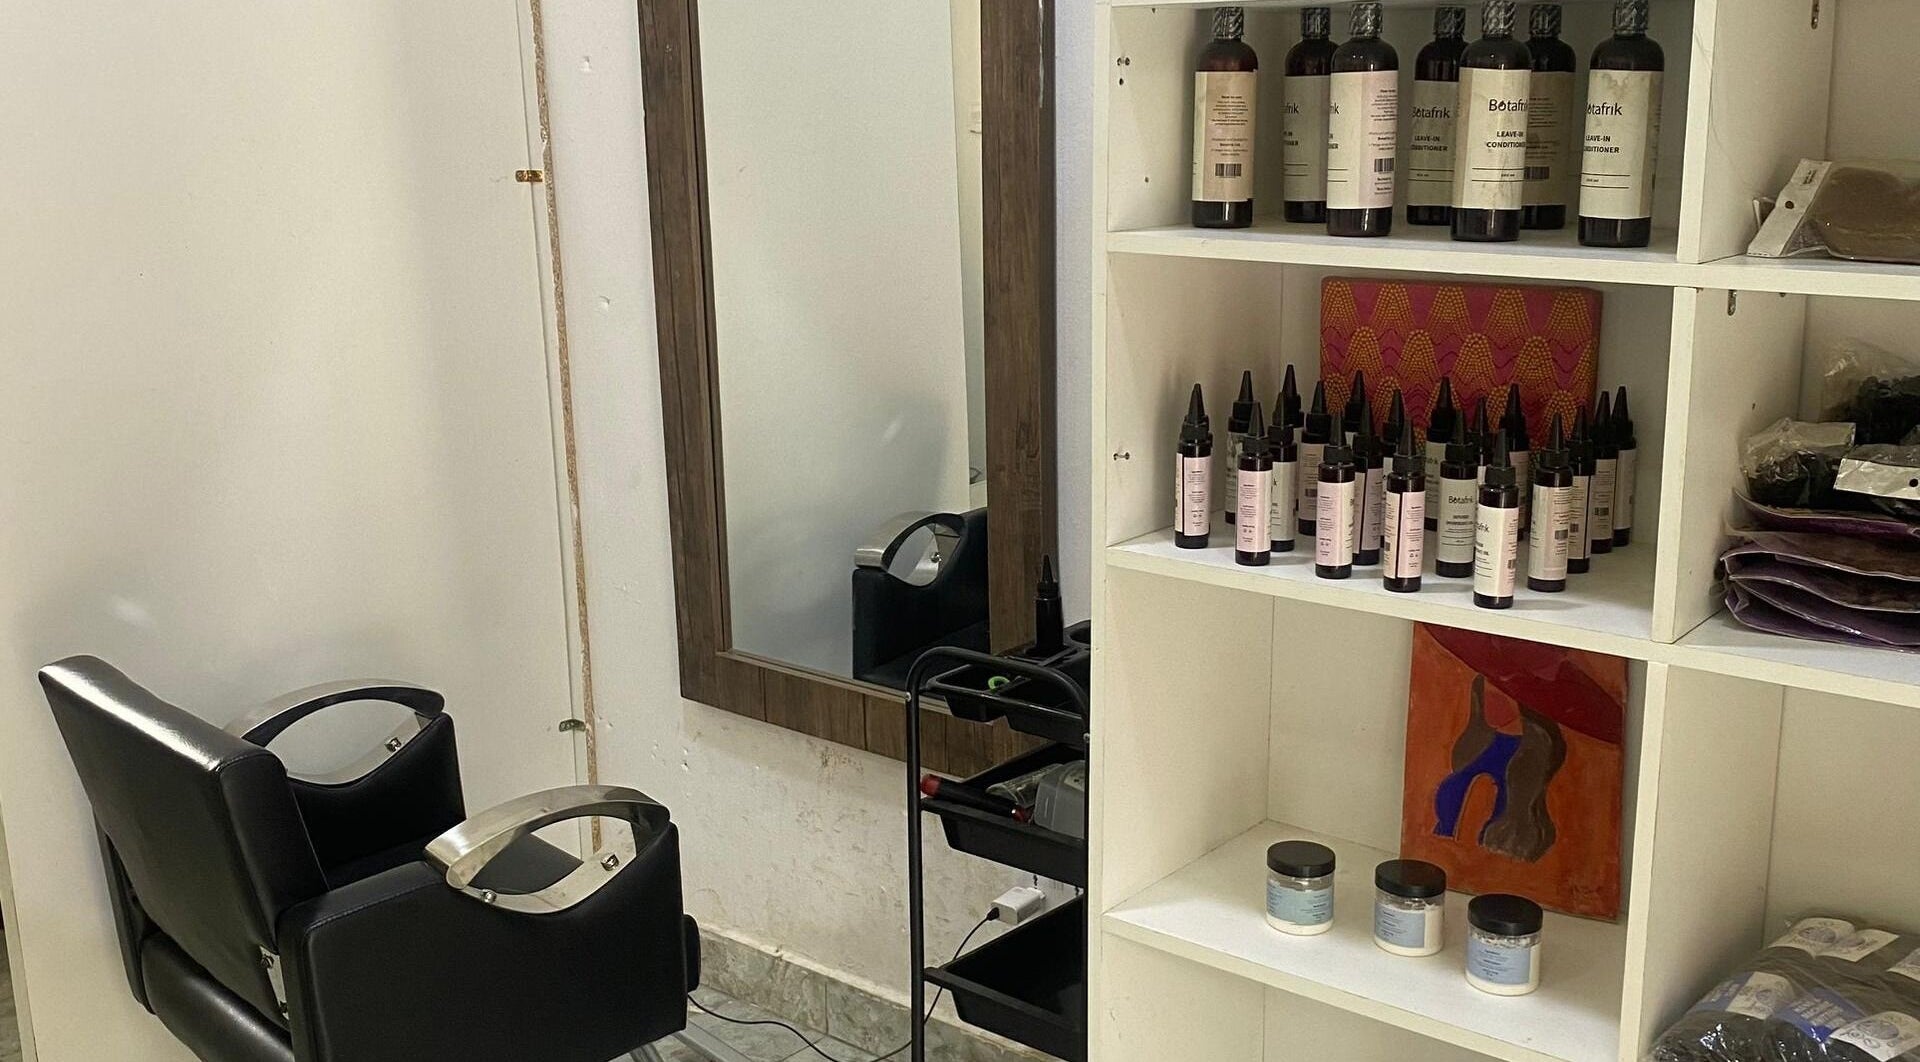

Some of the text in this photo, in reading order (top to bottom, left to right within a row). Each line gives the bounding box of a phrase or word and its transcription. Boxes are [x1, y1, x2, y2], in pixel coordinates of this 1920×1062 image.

[1488, 98, 1528, 112] Botafri
[1587, 102, 1622, 116] otafrik
[1585, 134, 1611, 142] LEAVE-IN
[1410, 144, 1448, 152] DITIONER
[1583, 145, 1620, 154] DITIONER
